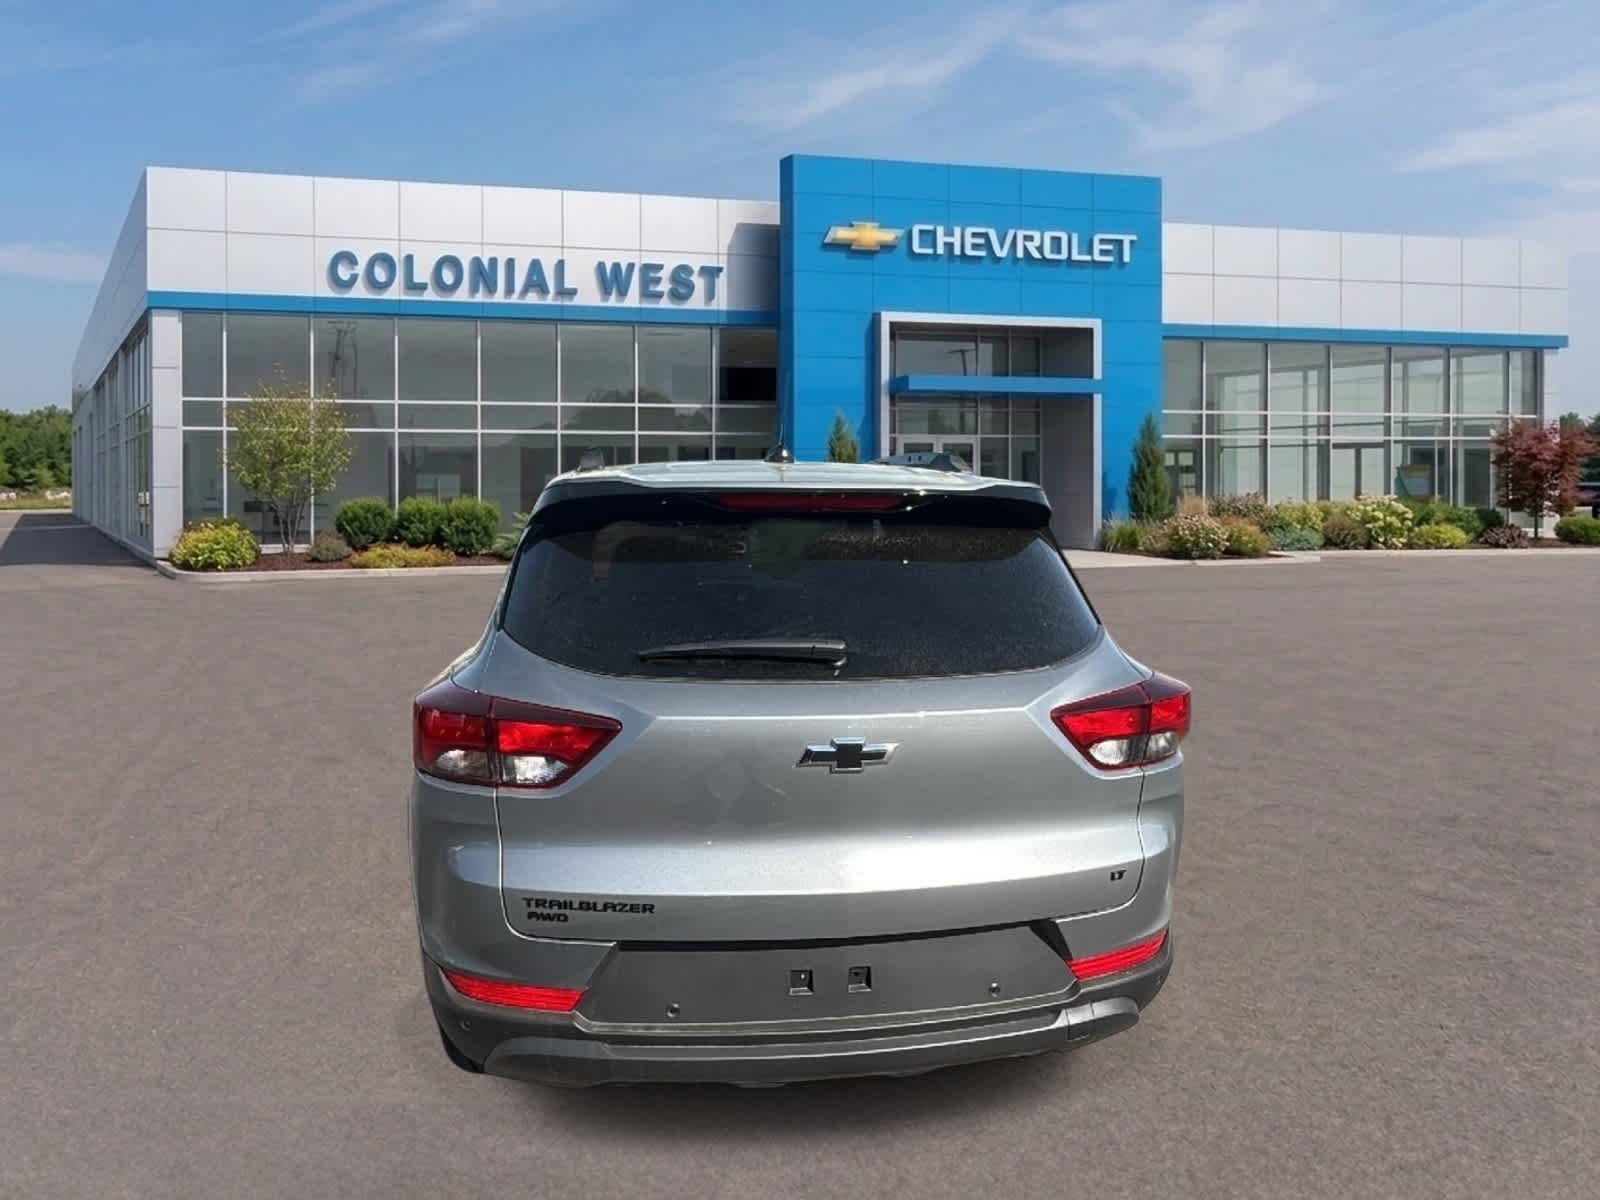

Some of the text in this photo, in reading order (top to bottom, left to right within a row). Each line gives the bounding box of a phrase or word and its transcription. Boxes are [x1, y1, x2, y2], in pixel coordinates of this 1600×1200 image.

[911, 223, 1137, 263] CHEVROLET
[328, 250, 724, 304] COLONIAL WEST
[1110, 869, 1127, 881] LT
[522, 897, 655, 914] TRAILBLAZER
[527, 911, 569, 922] AWD
